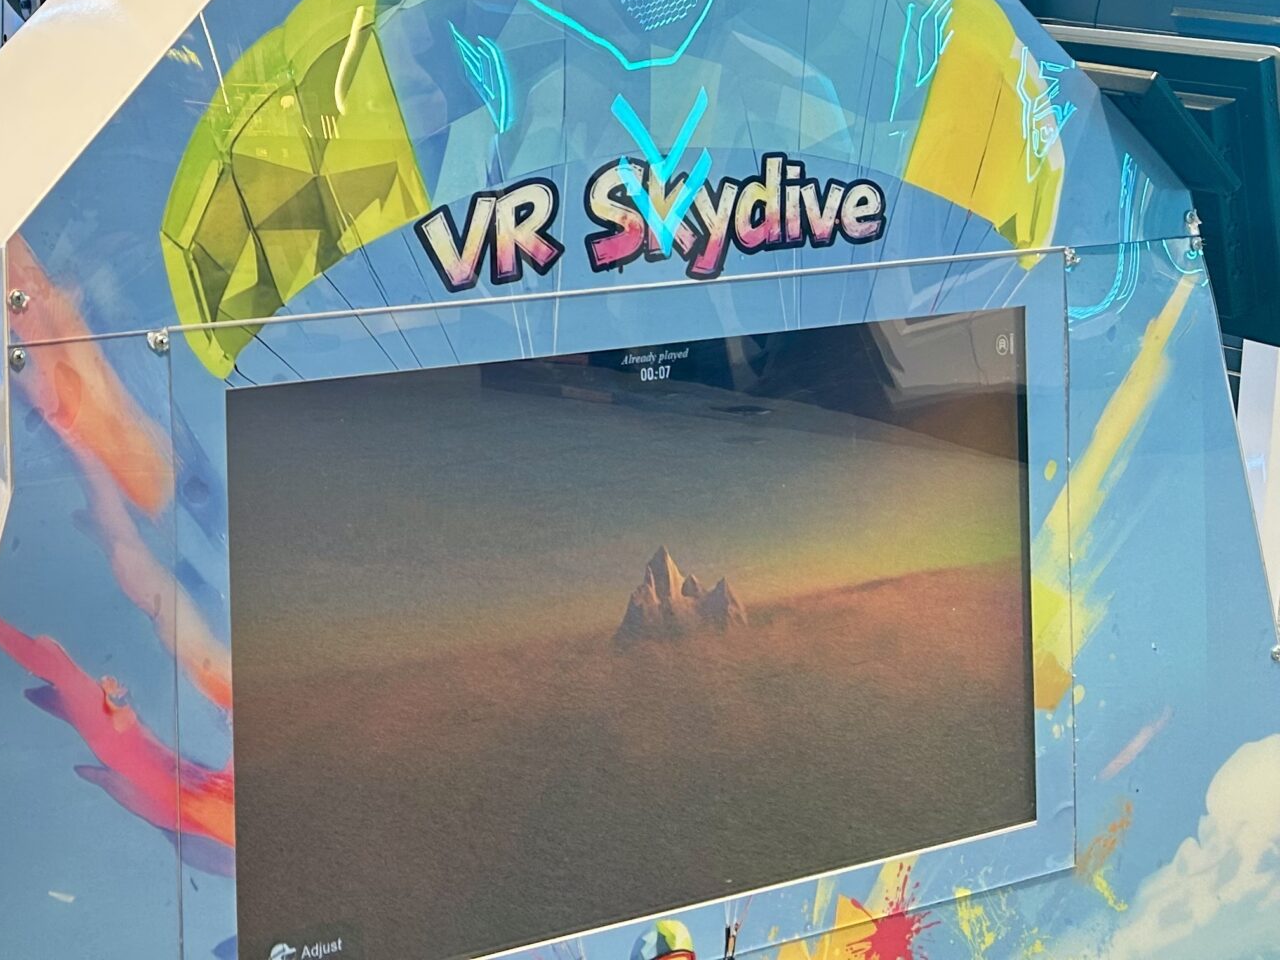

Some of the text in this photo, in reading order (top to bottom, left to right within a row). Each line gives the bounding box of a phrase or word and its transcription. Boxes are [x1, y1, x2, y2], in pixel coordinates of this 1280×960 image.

[414, 152, 886, 293] VR Skydive
[620, 347, 690, 367] Already played
[640, 365, 671, 382] 00:07
[301, 937, 343, 960] Adjust
